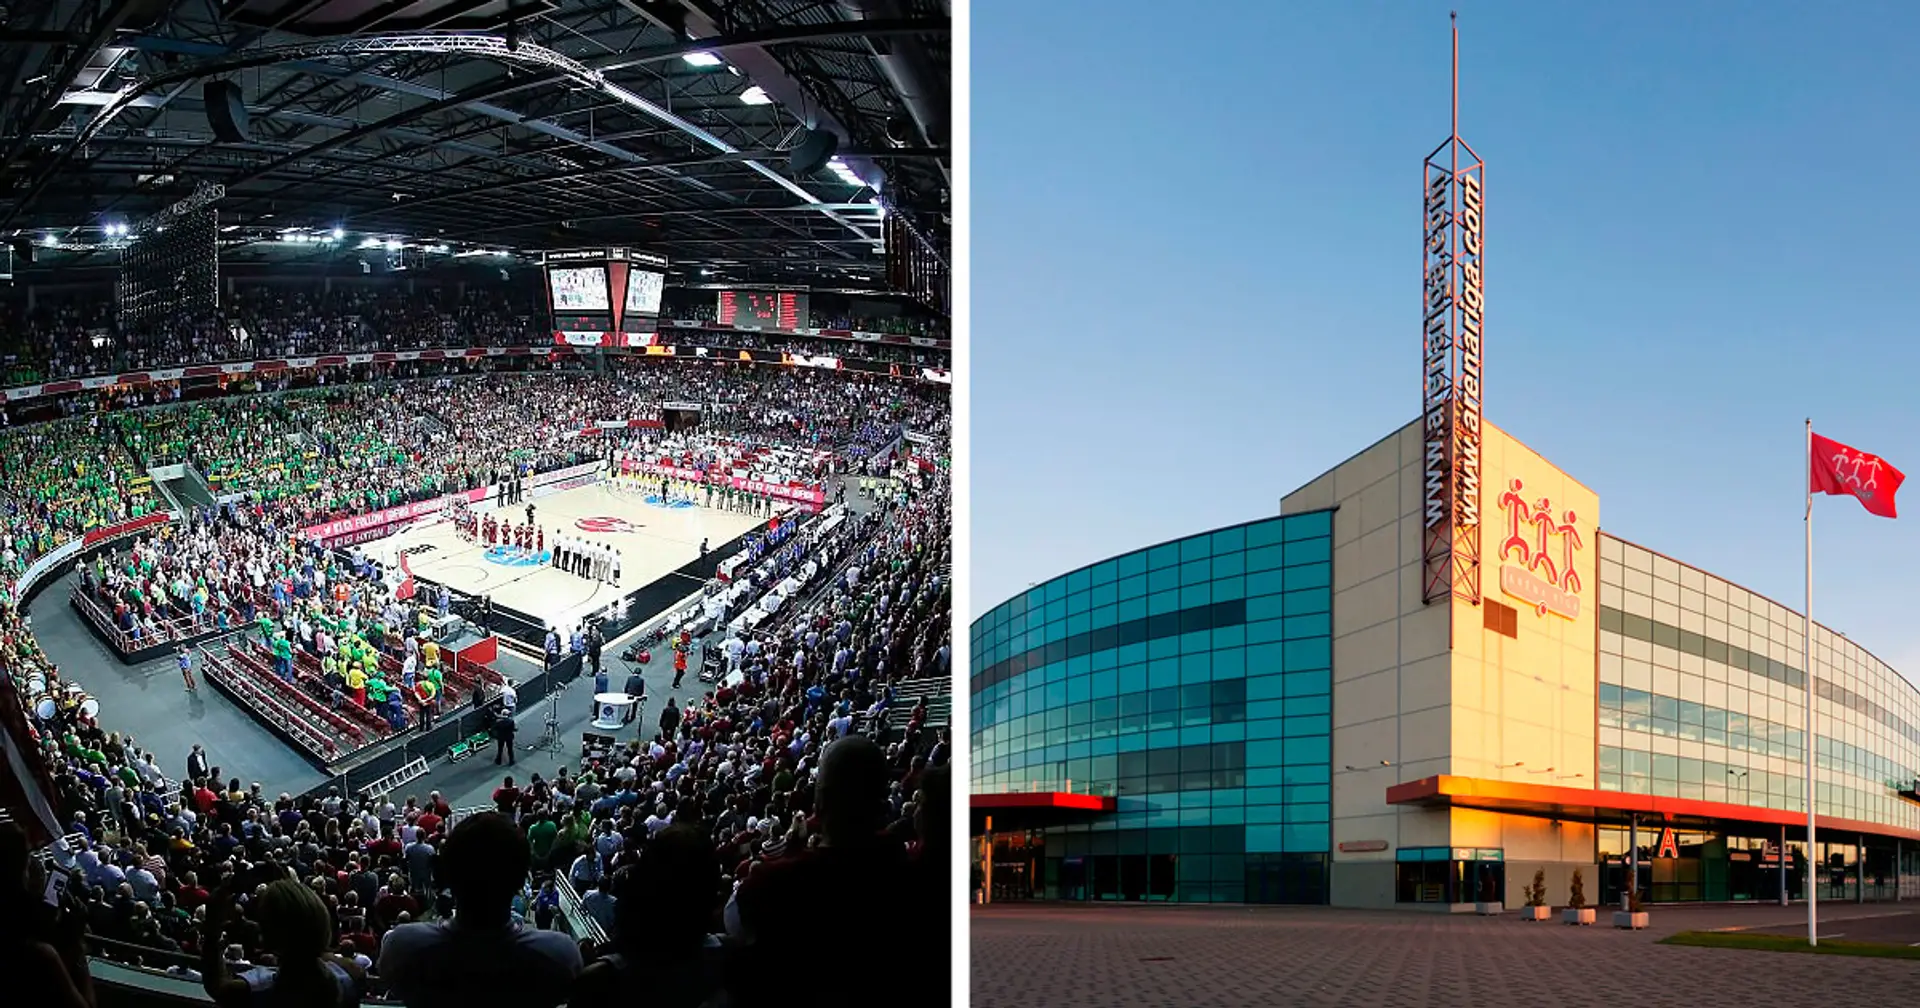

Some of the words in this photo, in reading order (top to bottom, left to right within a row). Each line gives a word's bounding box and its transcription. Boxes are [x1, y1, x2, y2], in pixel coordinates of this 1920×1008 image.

[1424, 172, 1450, 528] www.arenariga.com
[1459, 174, 1484, 526] www.arenariga.com
[1658, 827, 1678, 859] A
